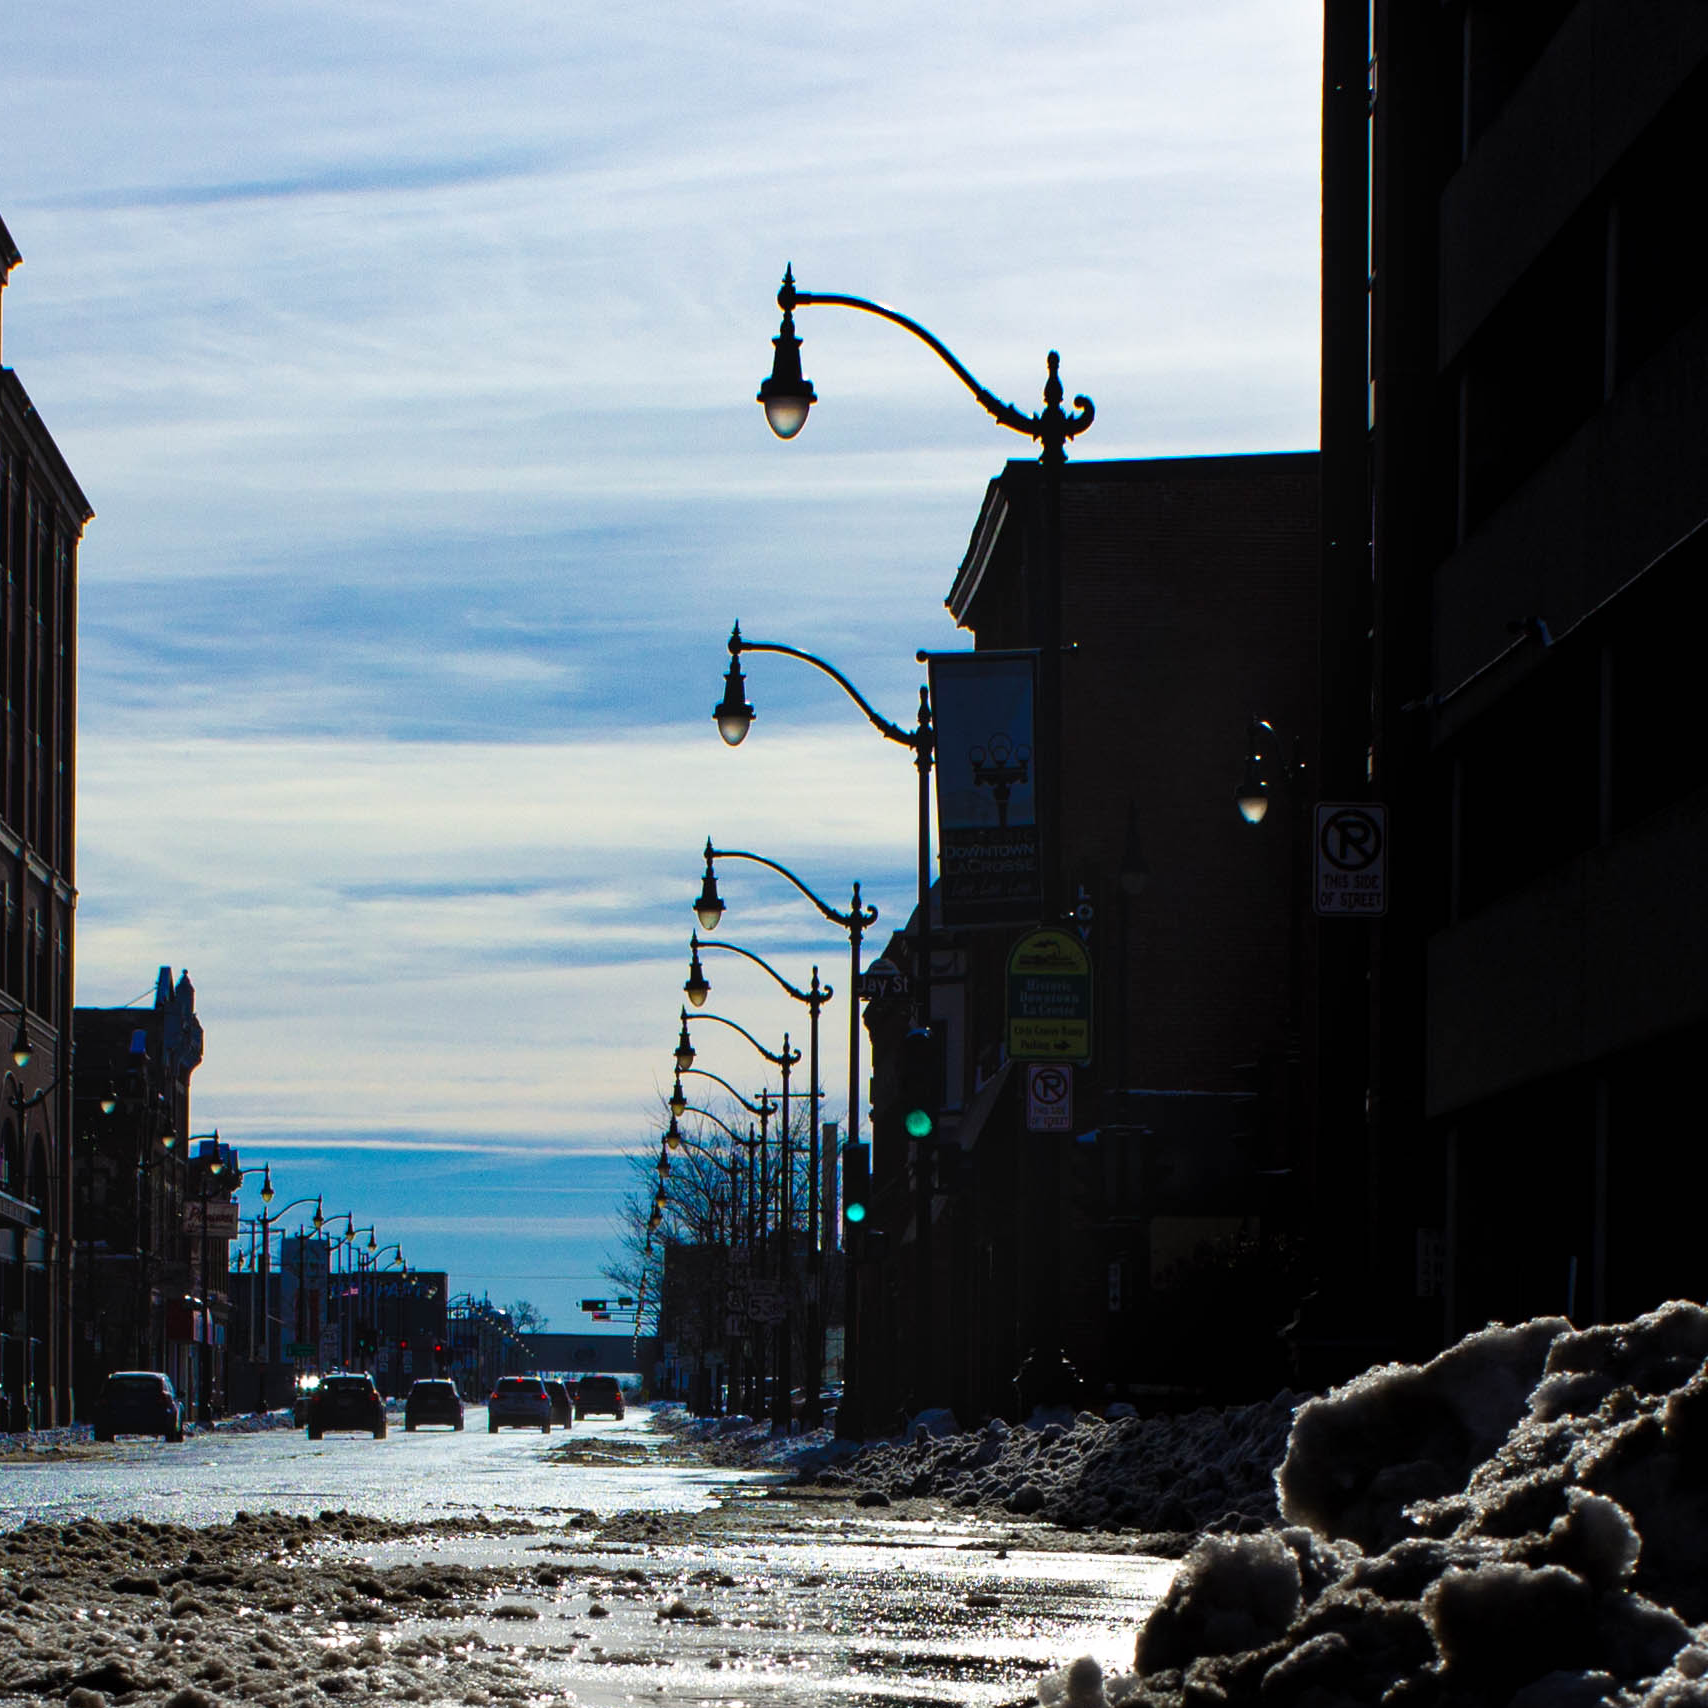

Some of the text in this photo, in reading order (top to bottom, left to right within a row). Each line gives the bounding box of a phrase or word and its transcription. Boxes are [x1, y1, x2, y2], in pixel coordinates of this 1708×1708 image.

[944, 843, 1036, 859] DOWNTOWN
[1323, 873, 1380, 889] THIS SIDE
[1320, 891, 1381, 906] OF STREET
[1076, 882, 1093, 944] LOV
[856, 975, 909, 1000] Jay St
[1025, 978, 1072, 992] Historic
[1020, 991, 1080, 1004] Downtown
